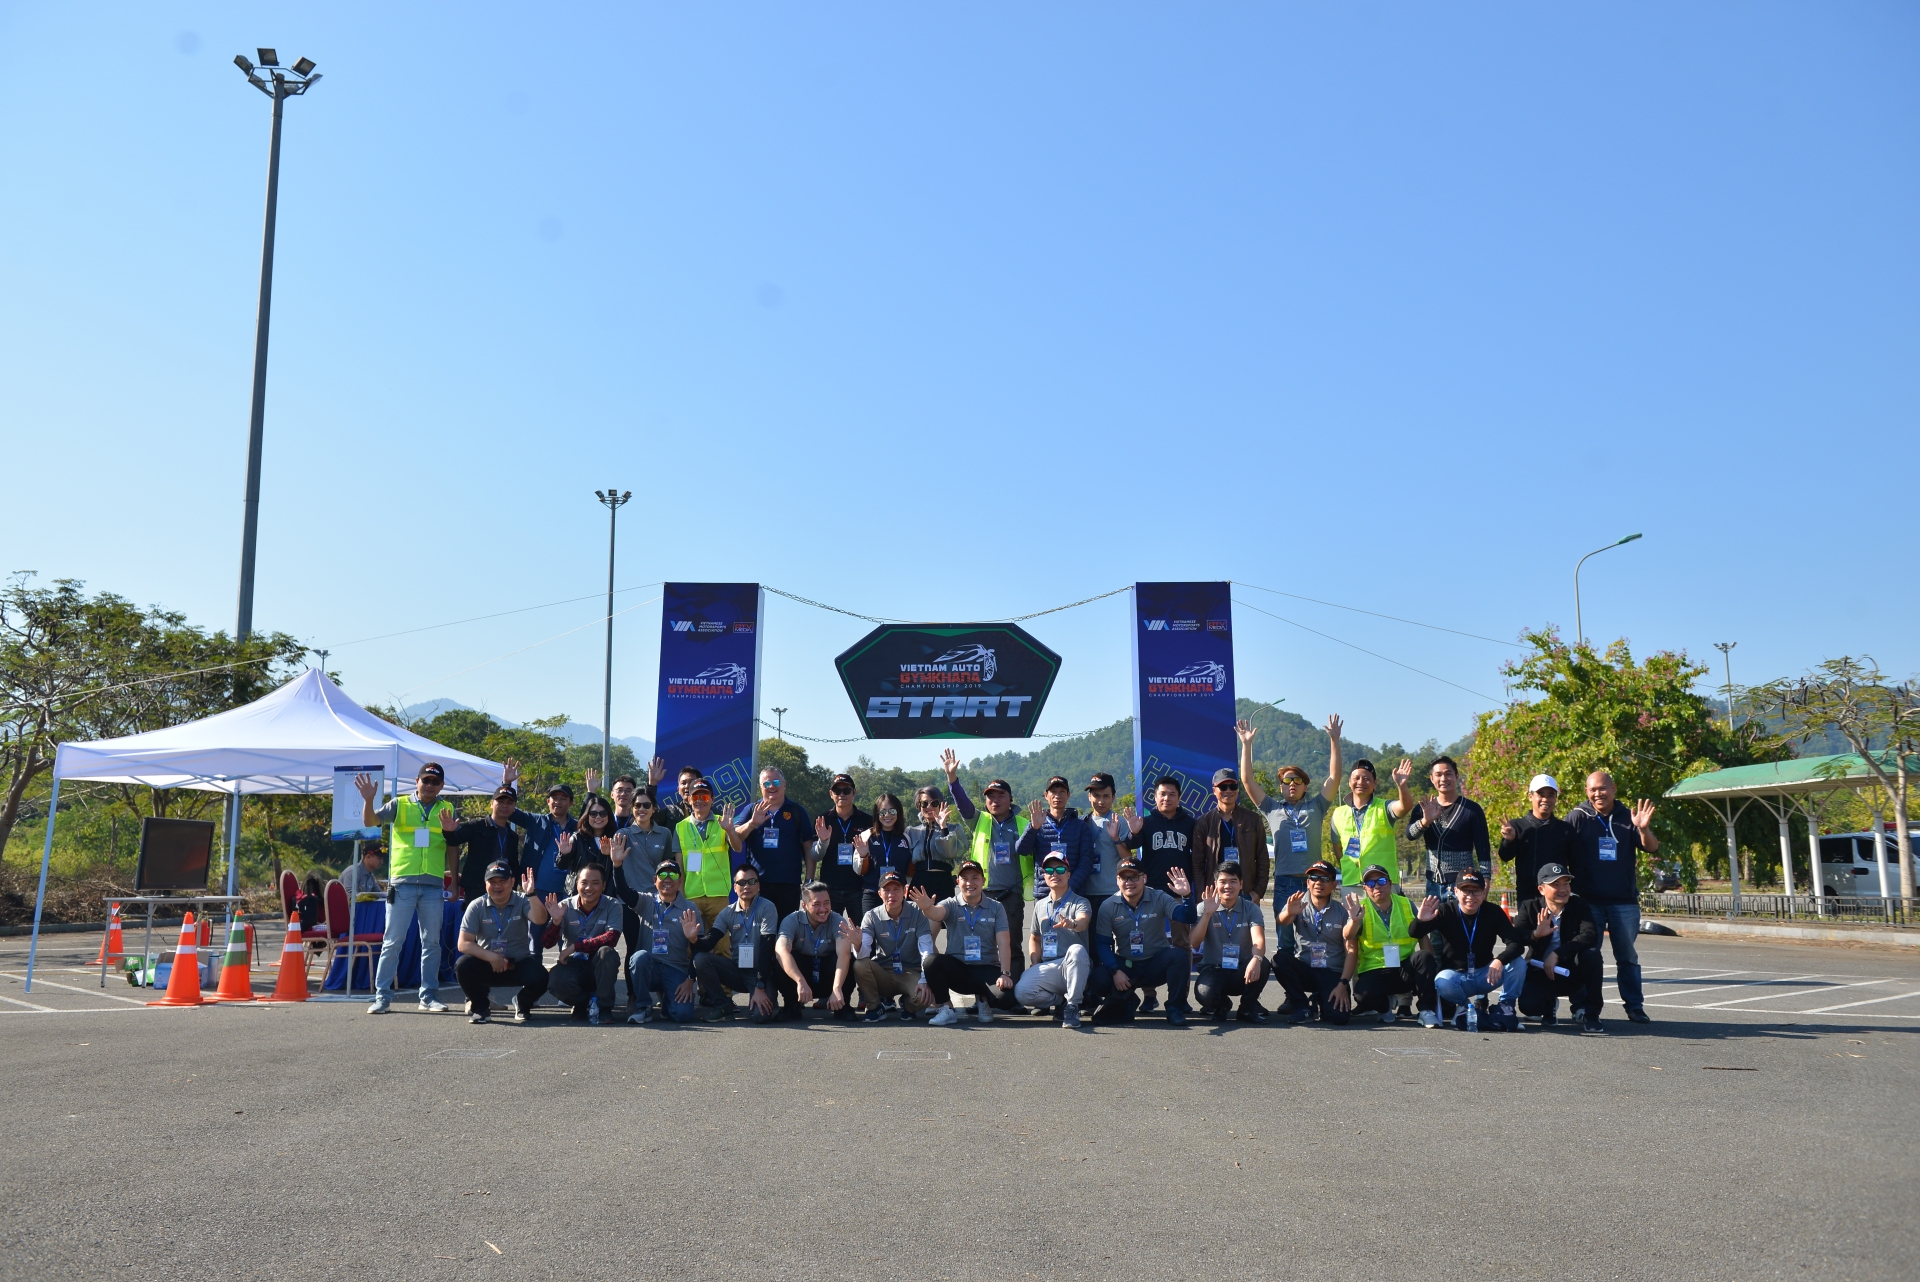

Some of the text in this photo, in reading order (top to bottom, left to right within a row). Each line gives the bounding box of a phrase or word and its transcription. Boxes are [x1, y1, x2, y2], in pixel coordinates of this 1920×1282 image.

[900, 664, 981, 672] VIETNAM AUTO
[668, 677, 707, 685] VIETNAM
[900, 672, 981, 683] GYMKHANA
[1148, 676, 1213, 684] VIETNAM AUTO
[667, 685, 734, 695] GYMKHANA
[1148, 683, 1214, 693] GYMKHANA
[866, 696, 1032, 718] START
[1152, 830, 1187, 852] GAP
